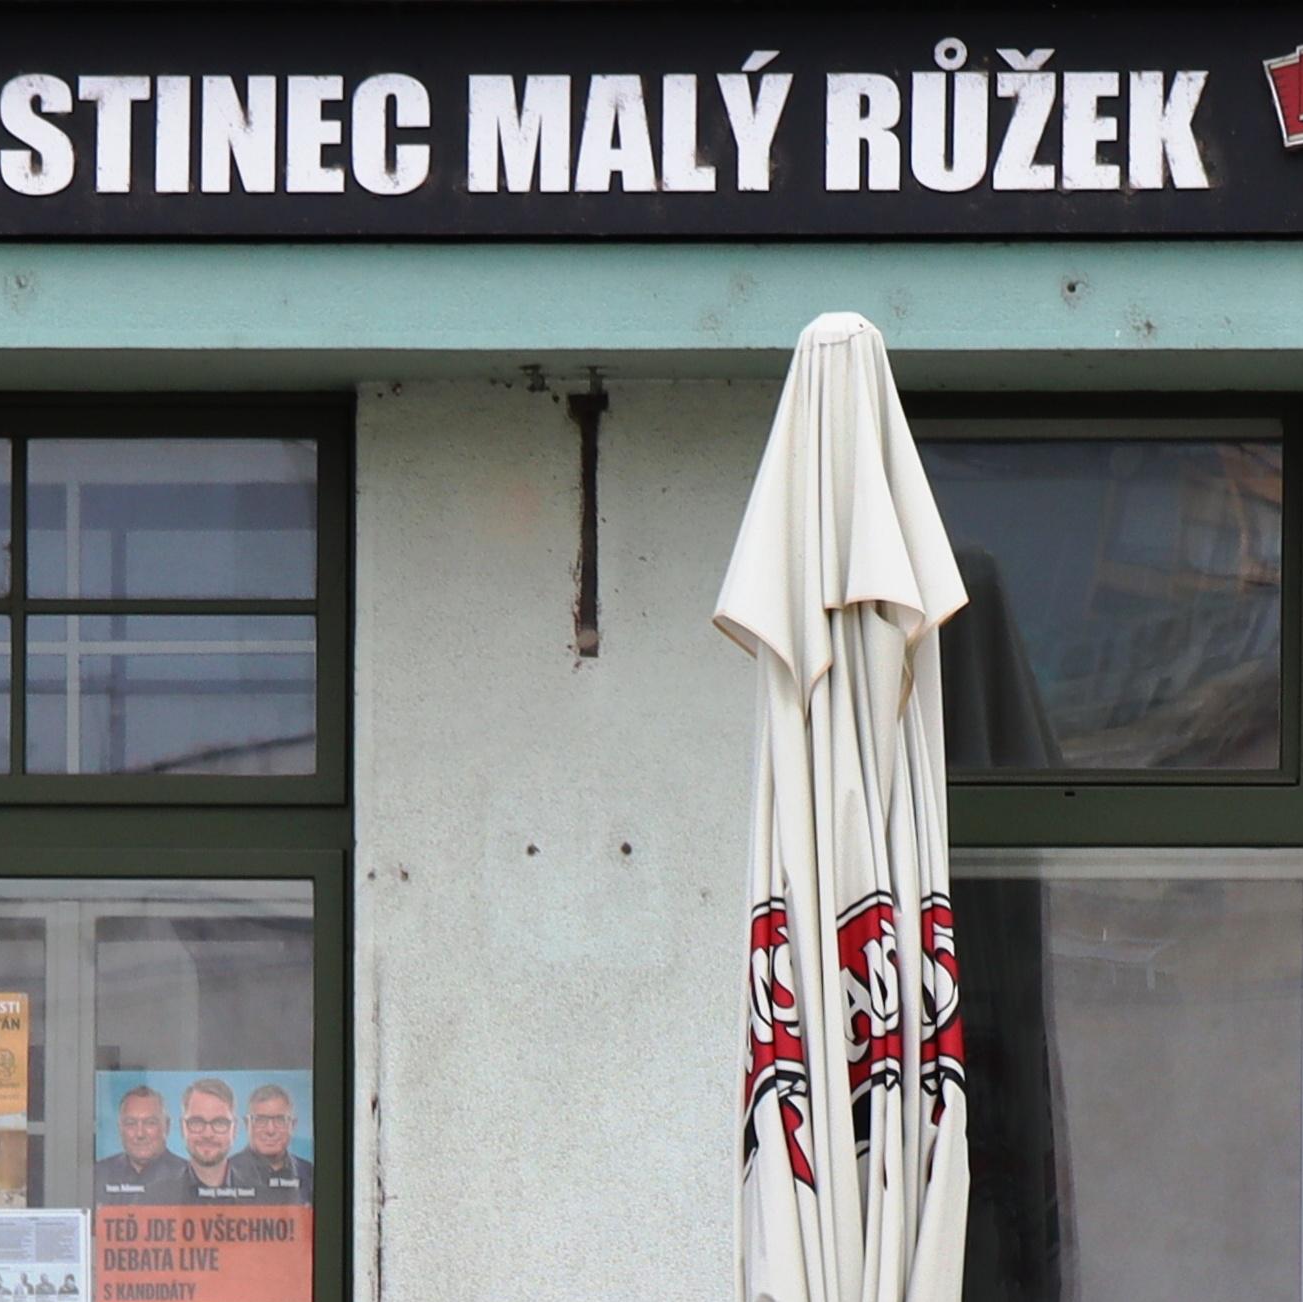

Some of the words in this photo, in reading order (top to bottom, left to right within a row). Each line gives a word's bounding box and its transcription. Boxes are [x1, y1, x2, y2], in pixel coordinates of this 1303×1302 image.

[468, 49, 794, 193] MALÝ
[825, 37, 1211, 193] RŮŽEK
[104, 1213, 138, 1242] TEĎ
[145, 1219, 176, 1242] JDE
[182, 1219, 196, 1242] O
[201, 1213, 295, 1242] VŠECHNO!
[104, 1247, 175, 1271] DEBATA
[180, 1247, 219, 1271] LIVE
[104, 1282, 113, 1301] S
[116, 1280, 197, 1301] KANDIDÁTY
